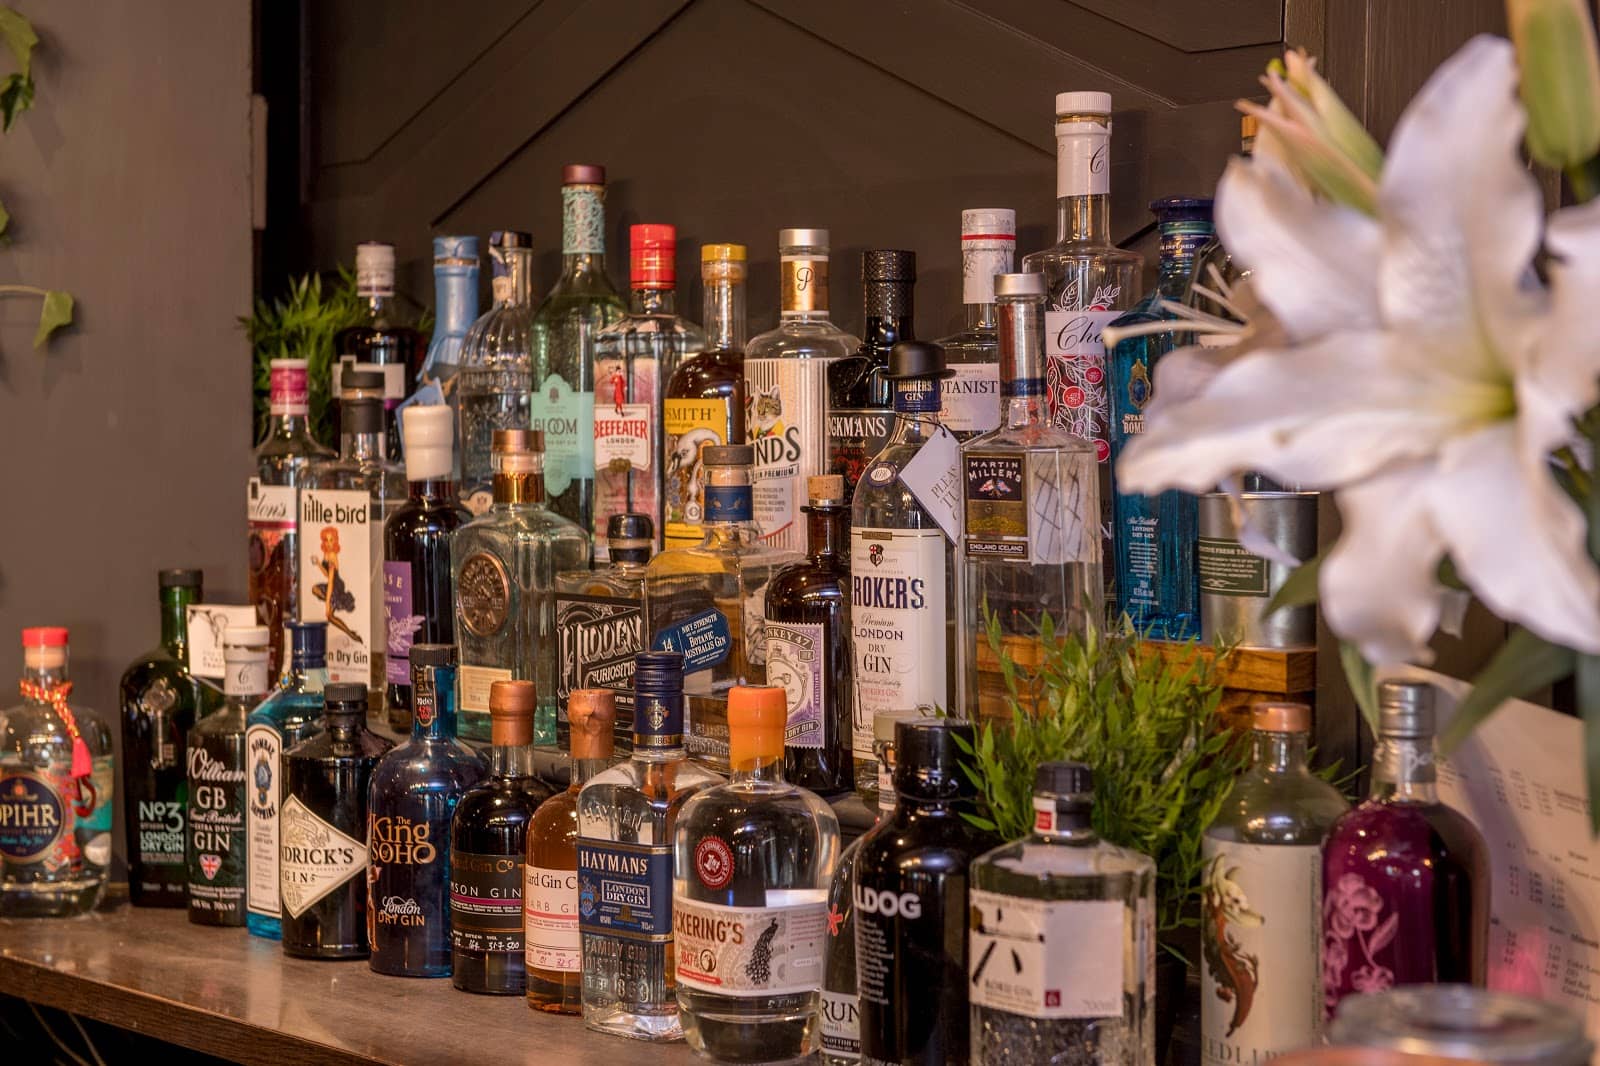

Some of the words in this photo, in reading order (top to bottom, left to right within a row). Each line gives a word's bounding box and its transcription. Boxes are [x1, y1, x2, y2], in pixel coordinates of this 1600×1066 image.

[904, 392, 925, 401] GIN
[593, 420, 648, 440] BEEFEATER
[764, 467, 794, 479] PREMIUM
[968, 469, 1022, 483] MILLER'S
[303, 493, 333, 524] little
[335, 503, 367, 524] bird
[969, 543, 997, 552] ENGLAND
[998, 544, 1024, 553] ICELAND
[850, 574, 924, 610] ROKER'S
[694, 613, 718, 630] STRENGTH
[861, 612, 895, 627] Premium
[688, 630, 715, 648] BOTANIC
[795, 635, 811, 647] 47
[854, 625, 903, 641] LONDON
[684, 641, 715, 660] AUSTRALIS
[714, 635, 727, 648] GIN
[868, 643, 887, 653] DRY
[336, 650, 351, 667] Dry
[353, 650, 368, 665] Gin
[556, 613, 643, 700] HIDDEN
[863, 653, 892, 674] GIN
[251, 738, 275, 759] BOMBAY
[196, 785, 227, 810] GB
[0, 803, 60, 828] PIHR
[250, 801, 277, 821] SAPPHIRE
[396, 815, 412, 825] The
[140, 831, 185, 842] LONDON
[368, 813, 431, 845] King
[140, 841, 162, 853] DRY
[163, 841, 185, 853] GIN
[194, 832, 231, 851] GIN
[284, 870, 308, 884] GIN
[541, 874, 562, 889] Gin
[489, 887, 522, 898] GIN
[605, 883, 646, 896] LONDON
[381, 895, 421, 915] London
[605, 892, 626, 902] DRY
[626, 894, 646, 905] GIN
[377, 911, 399, 926] DRY
[400, 914, 426, 927] GIN
